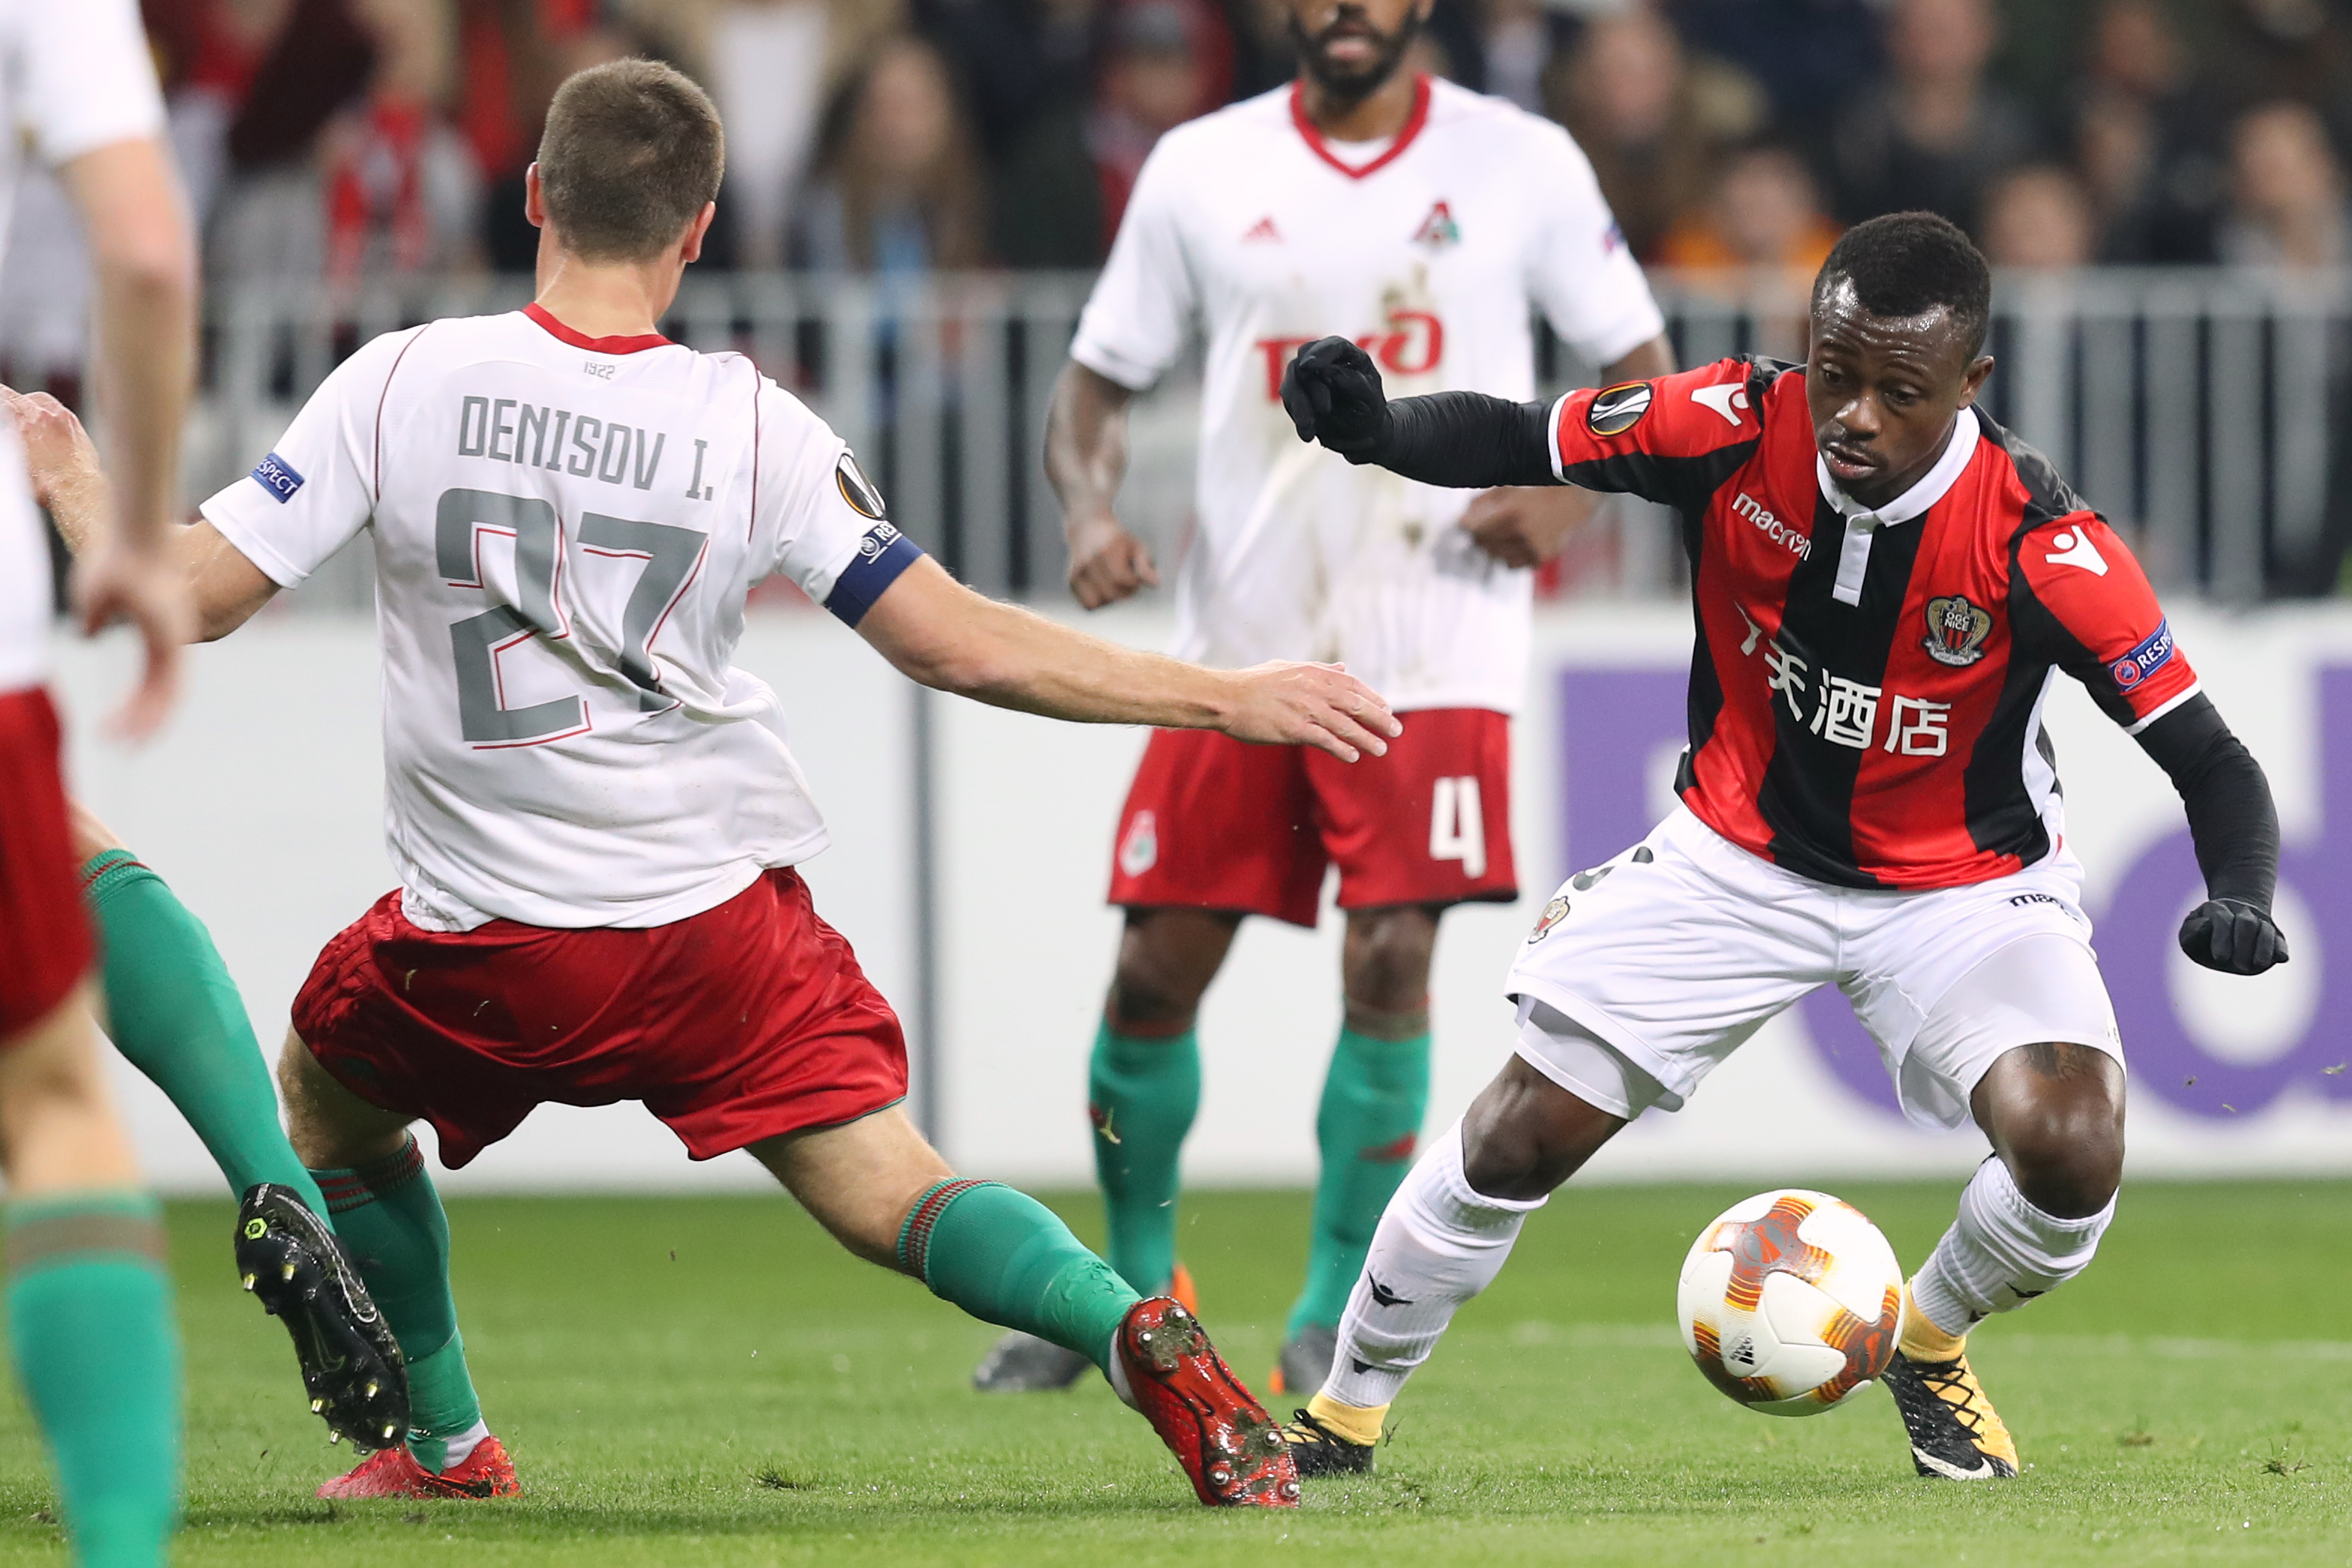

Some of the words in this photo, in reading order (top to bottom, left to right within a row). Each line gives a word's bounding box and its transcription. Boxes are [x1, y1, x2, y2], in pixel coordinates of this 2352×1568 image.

[584, 361, 615, 380] 1922
[458, 396, 666, 491] DENISOV
[685, 438, 714, 501] I.
[256, 459, 298, 495] SPECT
[435, 487, 709, 750] 27
[1944, 618, 1970, 632] NICE
[2136, 631, 2171, 669] RESP
[1429, 776, 1487, 880] 4
